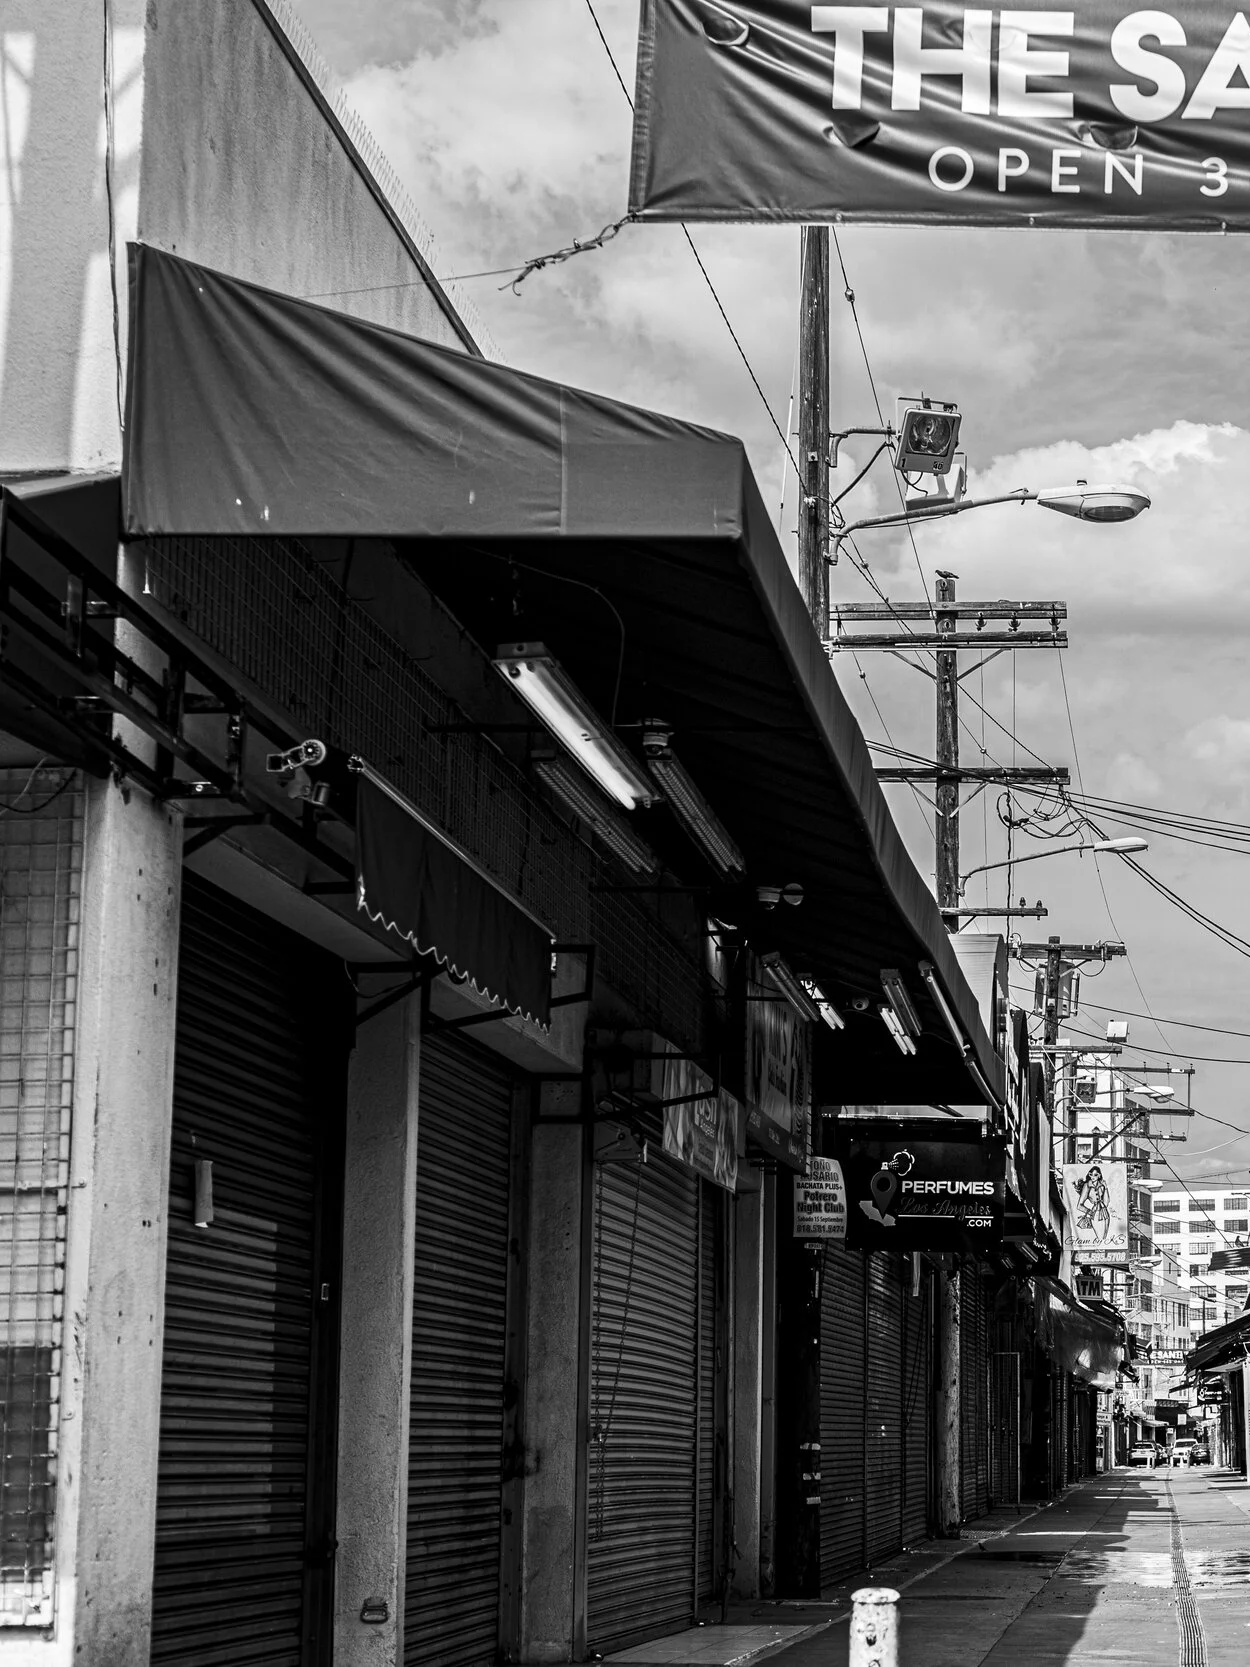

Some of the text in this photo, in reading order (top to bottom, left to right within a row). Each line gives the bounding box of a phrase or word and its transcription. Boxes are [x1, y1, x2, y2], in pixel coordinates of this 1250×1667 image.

[811, 5, 1075, 118] THE
[928, 146, 1144, 196] OPEN
[796, 1182, 824, 1190] BACHATA
[901, 1181, 995, 1195] PERFUMES
[804, 1190, 838, 1202] Potrero
[797, 1202, 845, 1215] Night Club
[895, 1197, 992, 1221] Los Angeles
[966, 1219, 992, 1227] .COM
[1065, 1236, 1091, 1246] Glam
